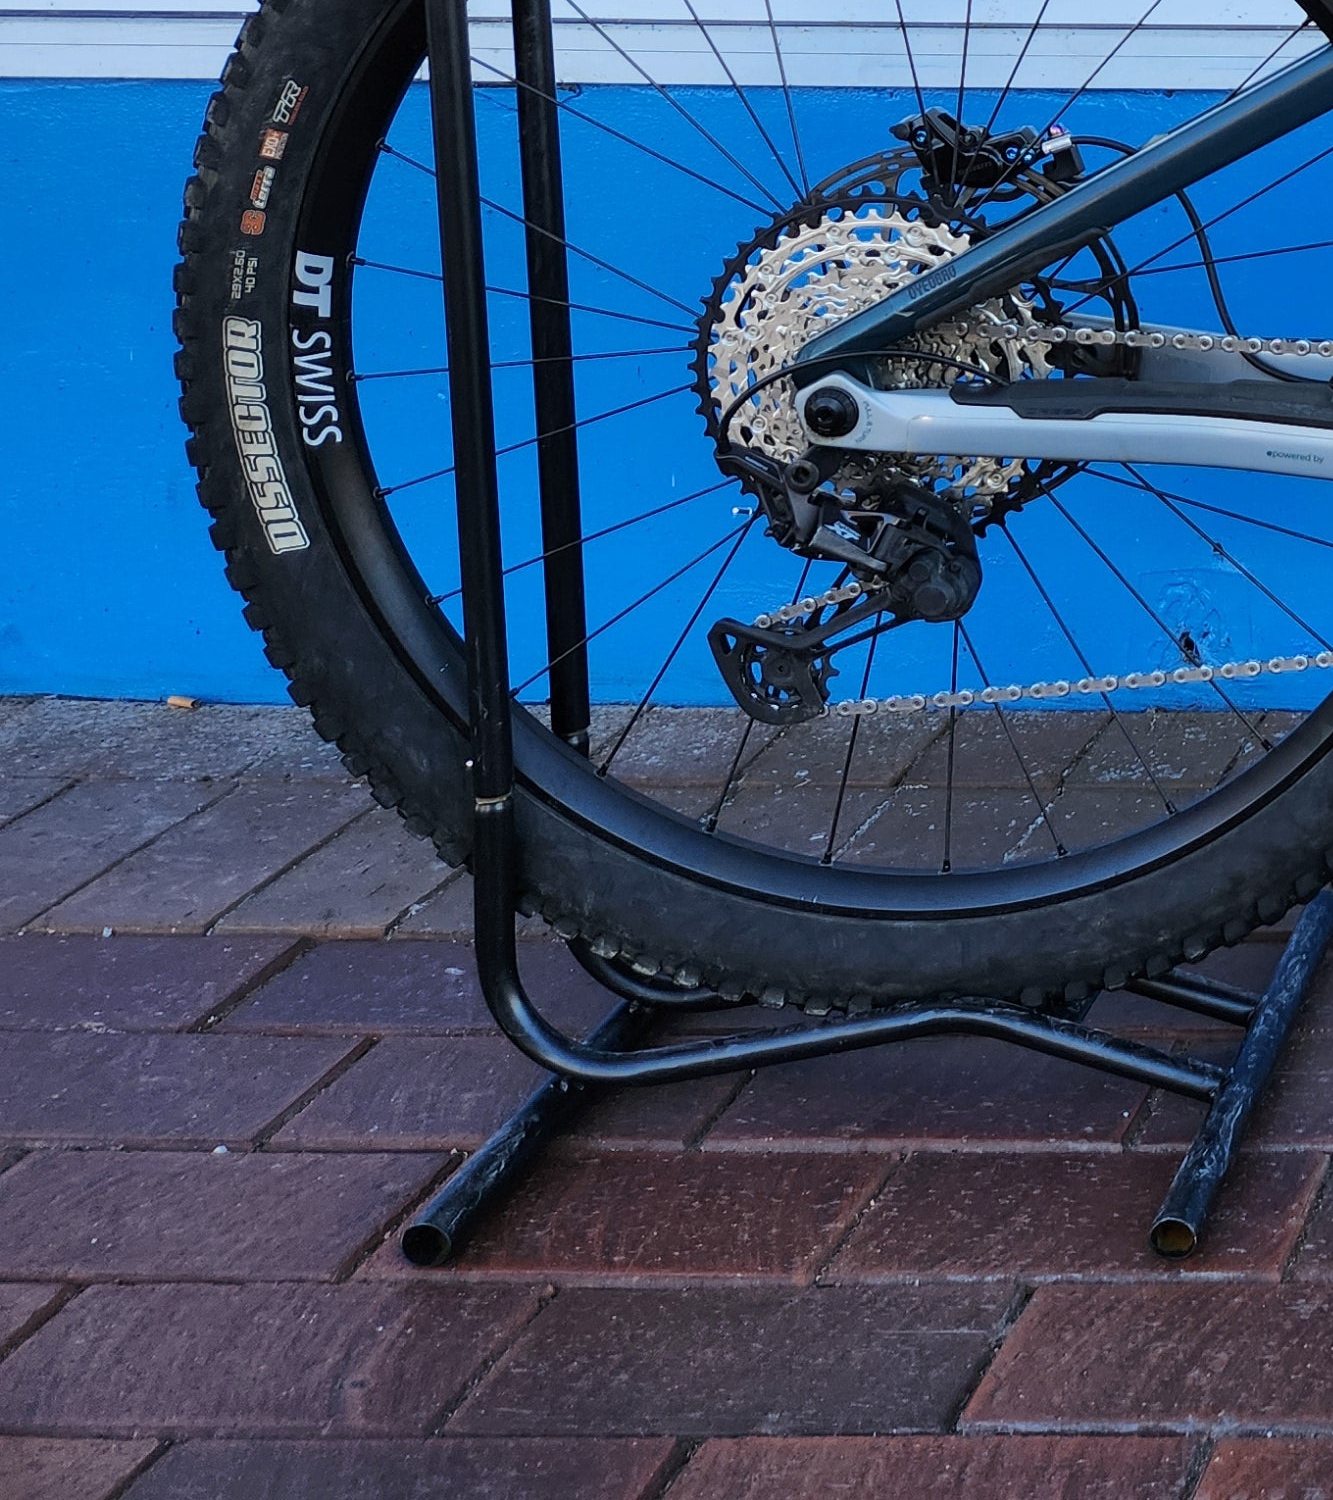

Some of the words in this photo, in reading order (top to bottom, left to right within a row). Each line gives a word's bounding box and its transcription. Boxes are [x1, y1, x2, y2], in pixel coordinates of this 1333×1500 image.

[272, 80, 302, 124] TR
[246, 257, 258, 275] PSI
[293, 250, 335, 318] DT
[292, 329, 343, 446] SWISS
[222, 315, 310, 555] DISSECTOR
